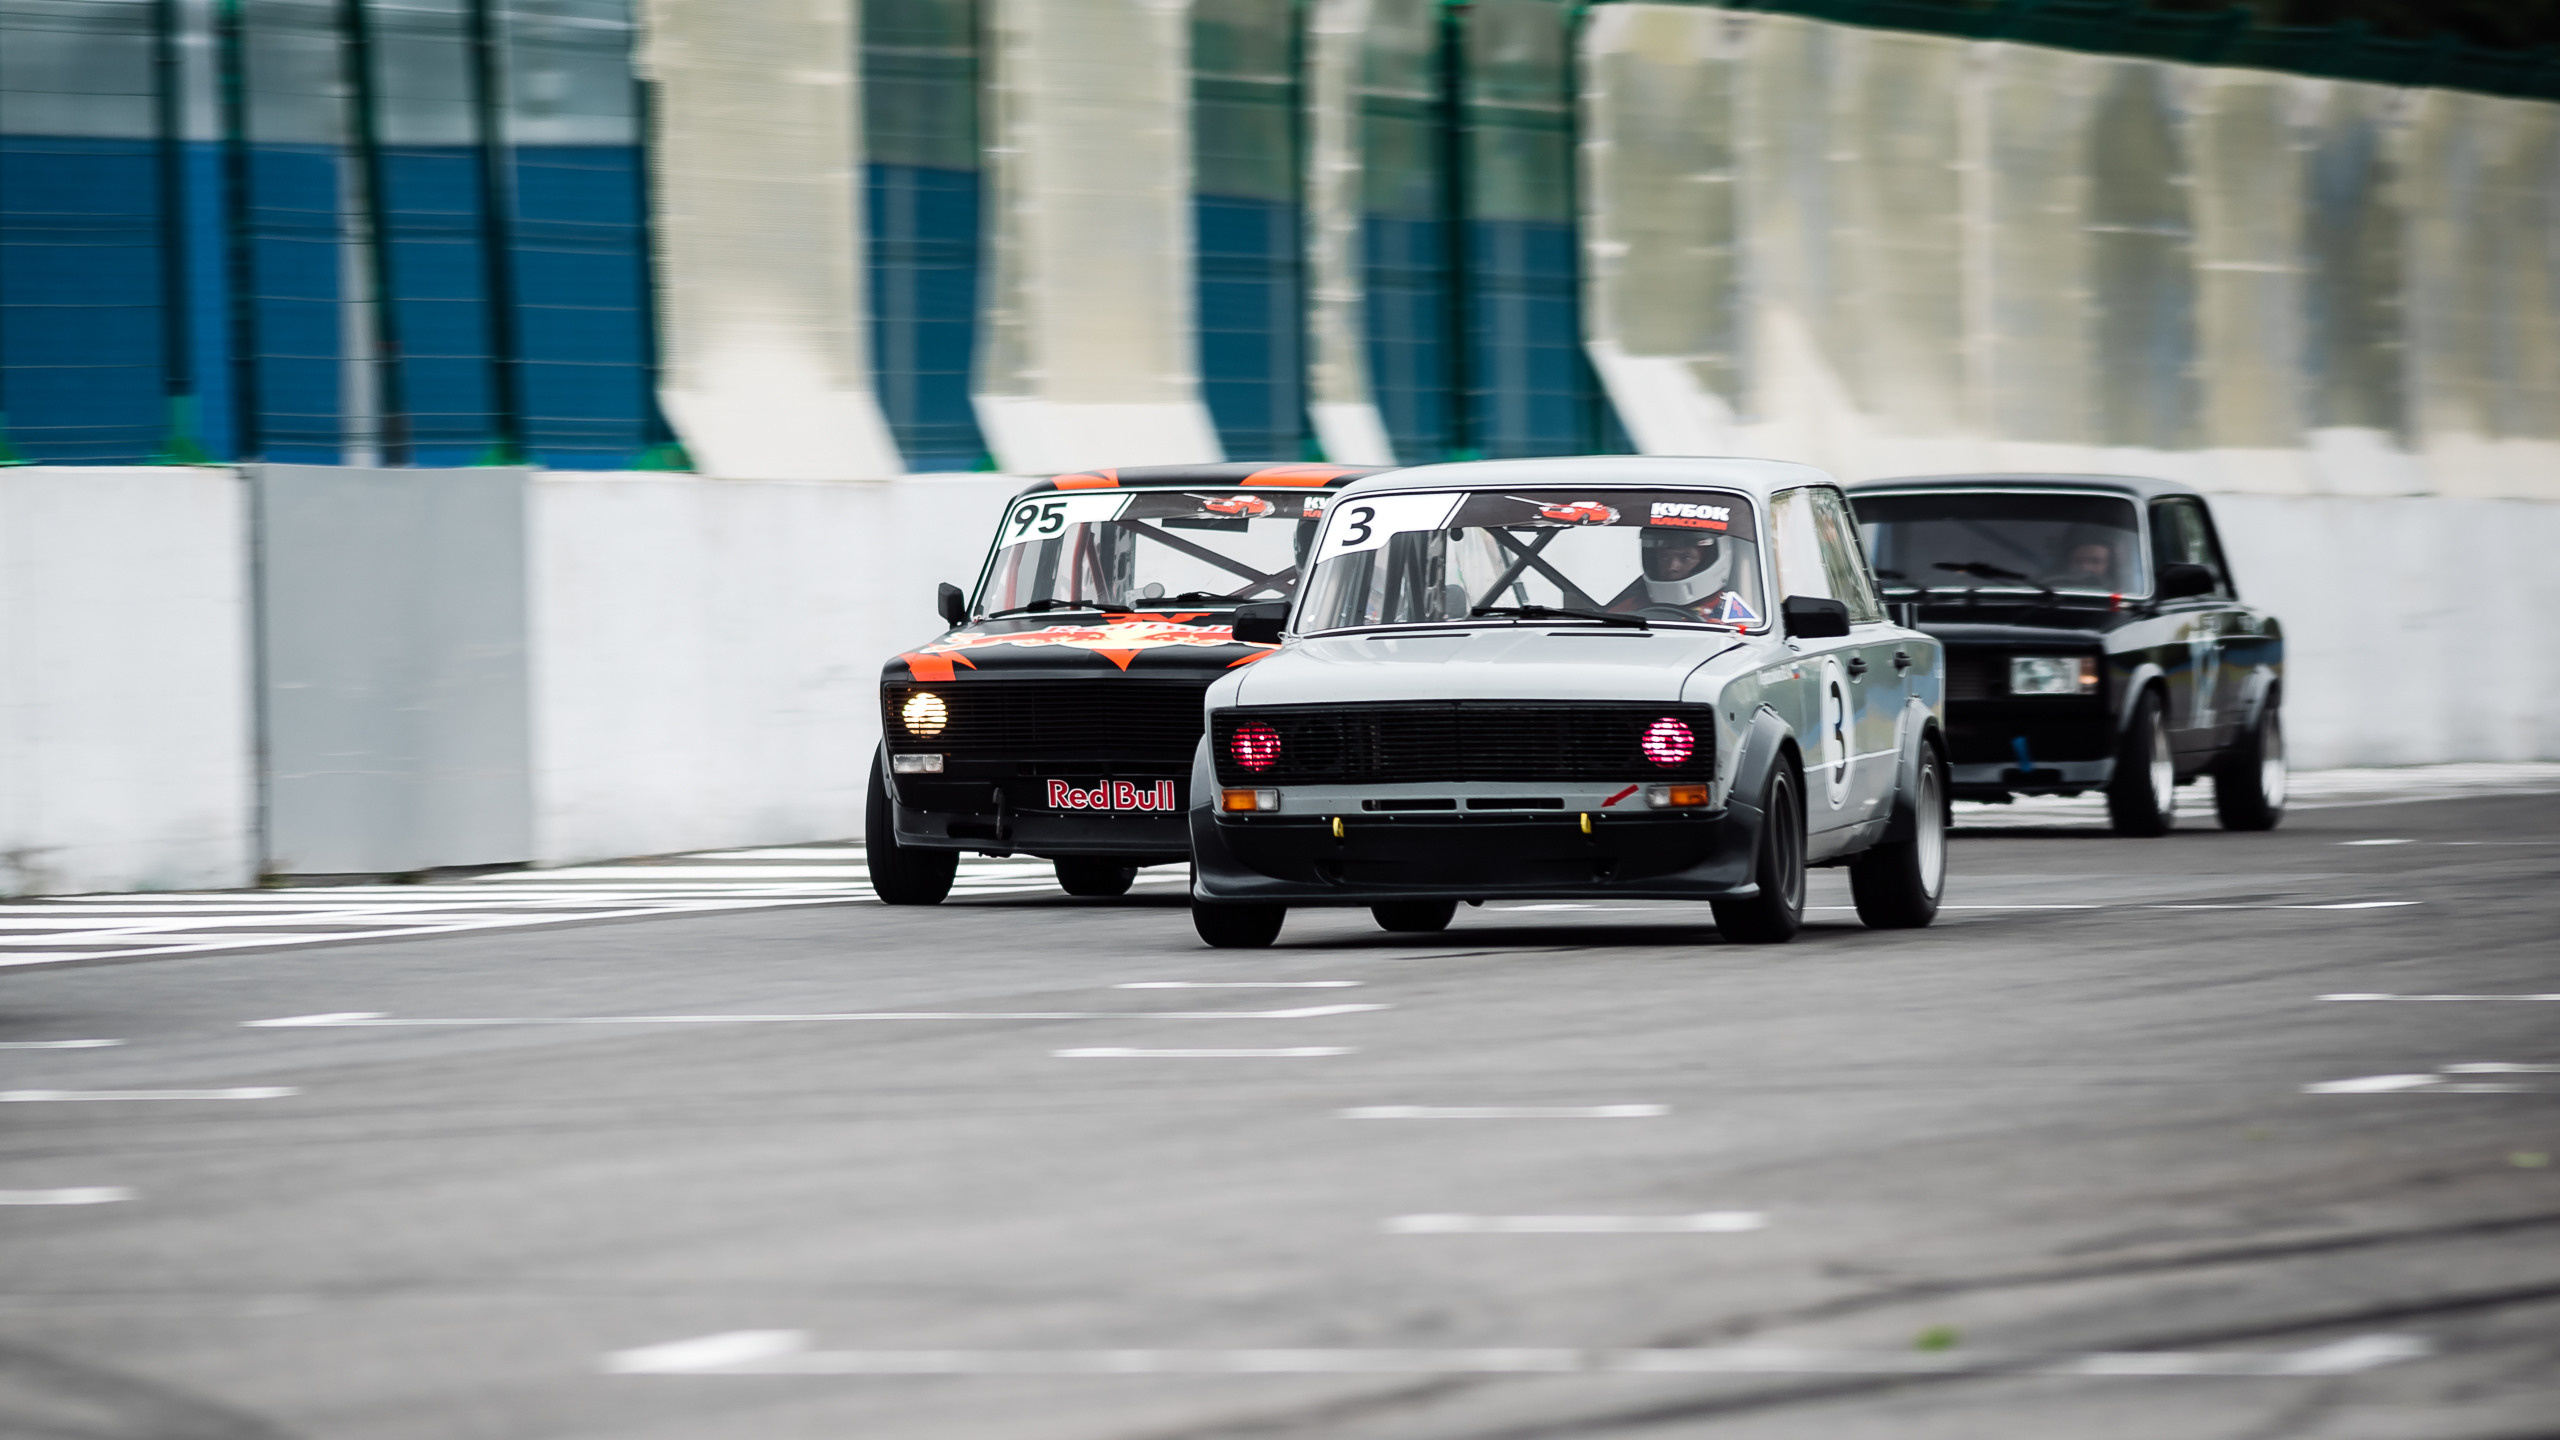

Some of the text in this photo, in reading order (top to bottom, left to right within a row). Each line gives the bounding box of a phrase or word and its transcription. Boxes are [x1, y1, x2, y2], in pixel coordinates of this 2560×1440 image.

[1015, 502, 1068, 538] 95
[1342, 506, 1376, 546] 3
[1650, 502, 1731, 521] КУБОК
[1830, 680, 1846, 785] 3
[1047, 779, 1175, 811] Red Bull
